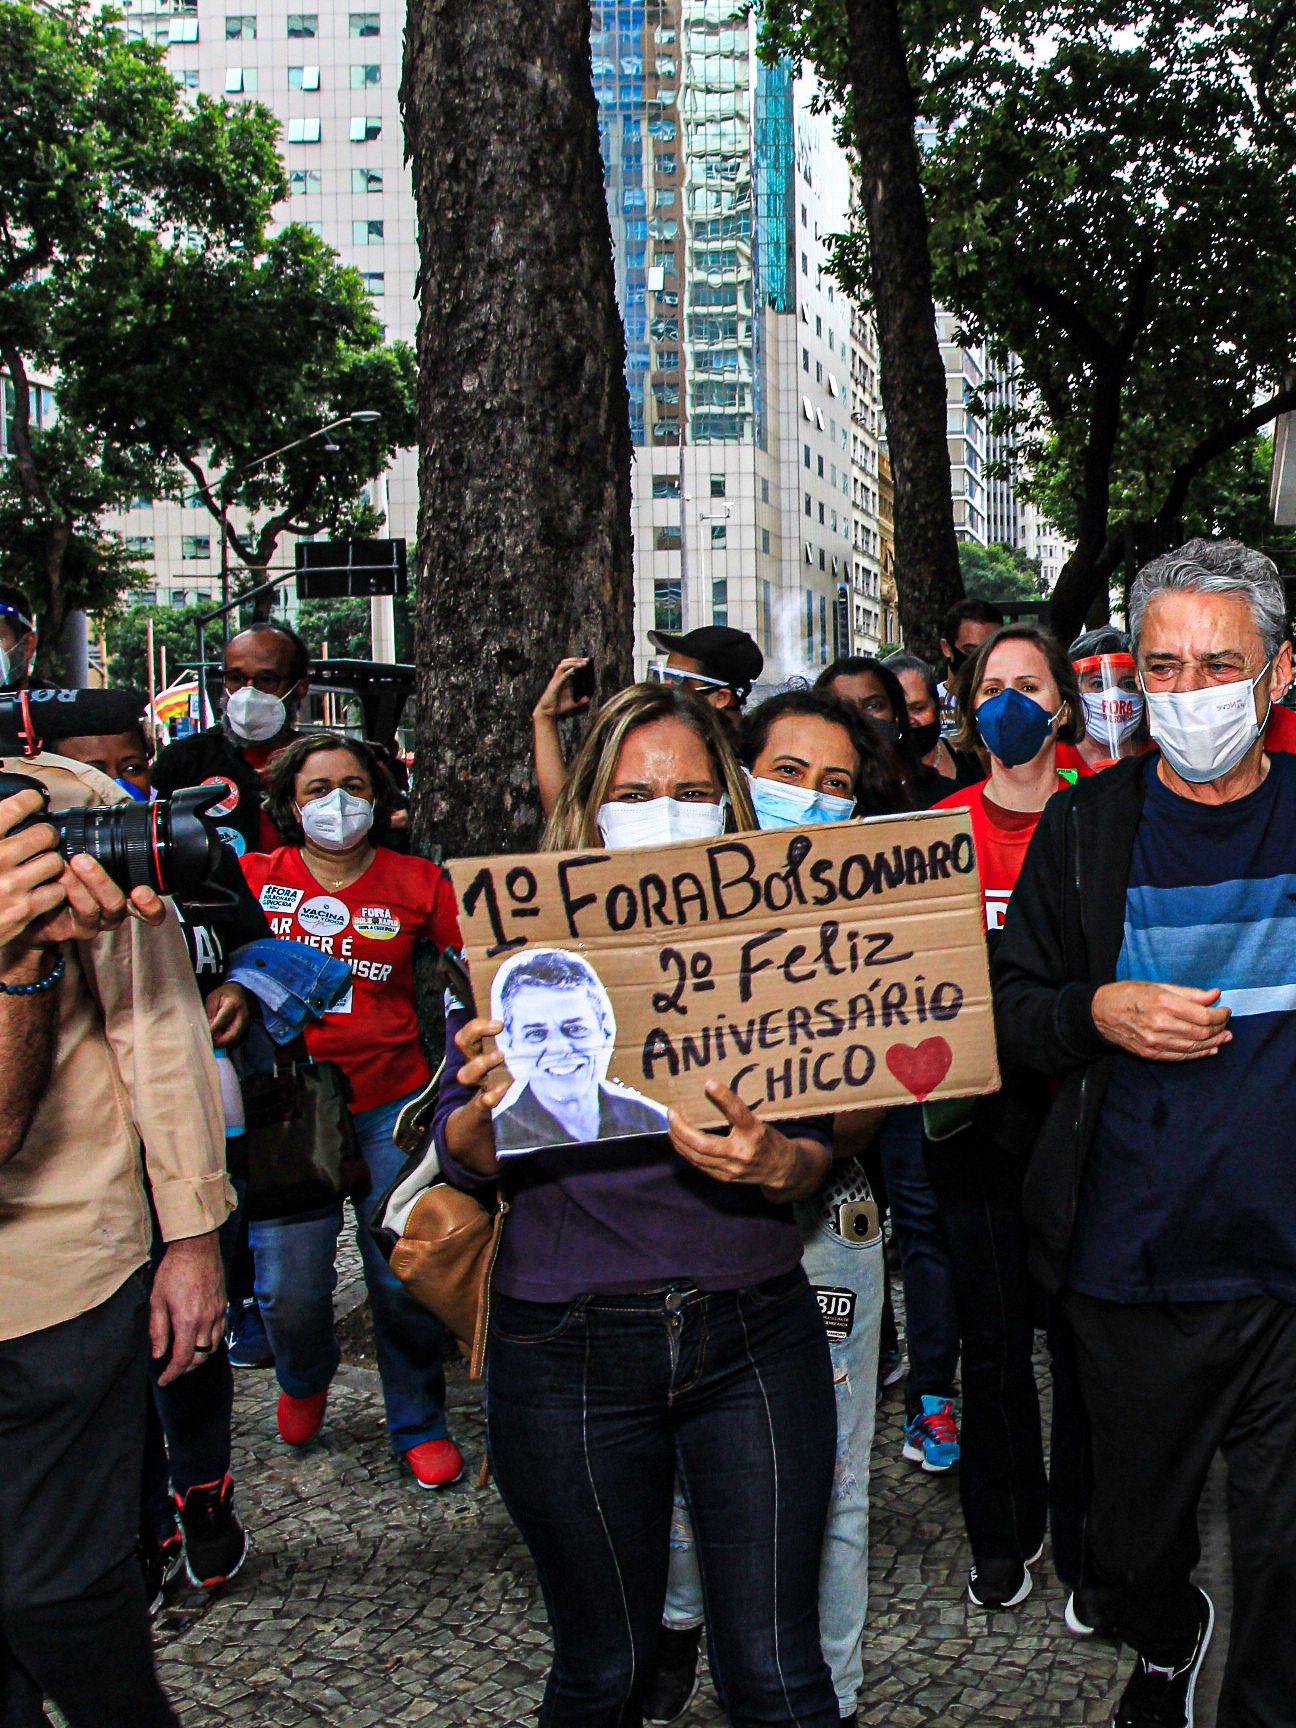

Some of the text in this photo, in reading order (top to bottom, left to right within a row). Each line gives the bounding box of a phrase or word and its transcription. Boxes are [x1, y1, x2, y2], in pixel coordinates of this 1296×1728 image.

[1101, 699, 1134, 715] FORA
[302, 907, 345, 921] VACINA
[462, 865, 541, 958] 1º
[558, 854, 708, 938] FORA
[270, 917, 293, 935] AR
[650, 946, 715, 1015] 2º
[816, 1295, 851, 1316] BJD
